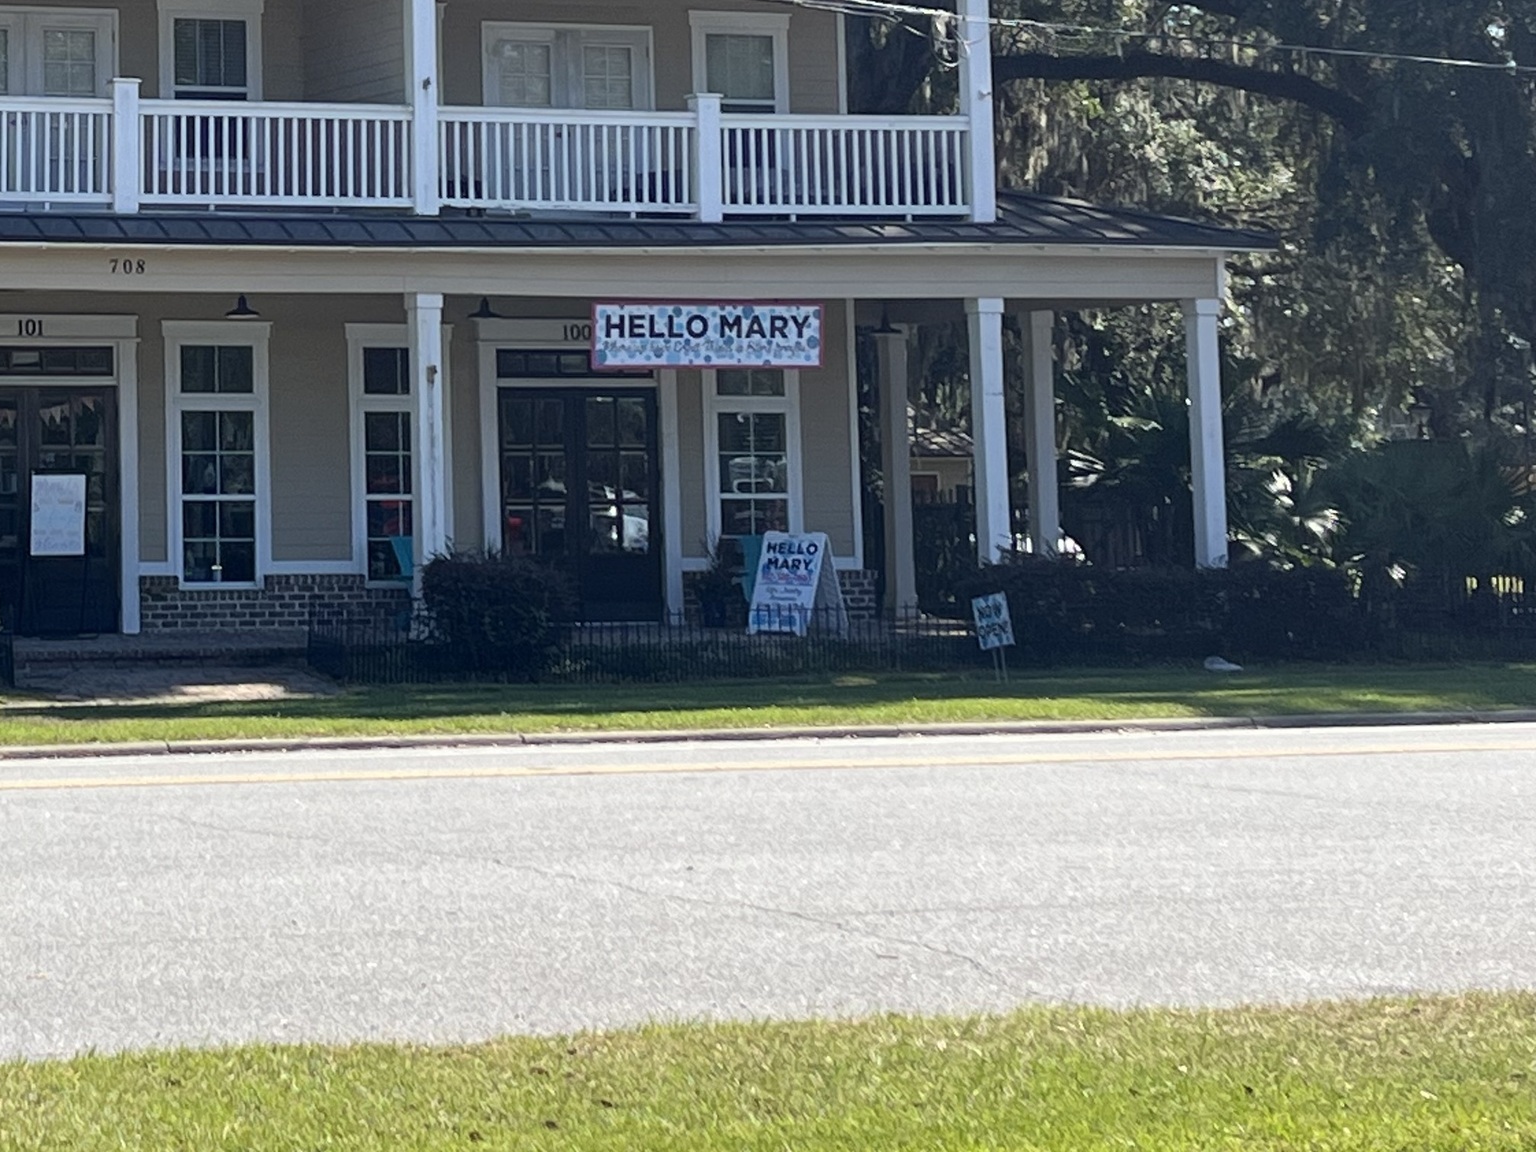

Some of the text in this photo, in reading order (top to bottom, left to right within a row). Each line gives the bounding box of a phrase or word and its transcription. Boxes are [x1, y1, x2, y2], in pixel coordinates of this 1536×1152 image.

[109, 259, 146, 274] 708
[18, 319, 43, 336] 101
[563, 324, 591, 341] 100
[605, 314, 810, 339] HELLO MARY
[766, 541, 818, 555] HELLO
[767, 556, 813, 571] MARY
